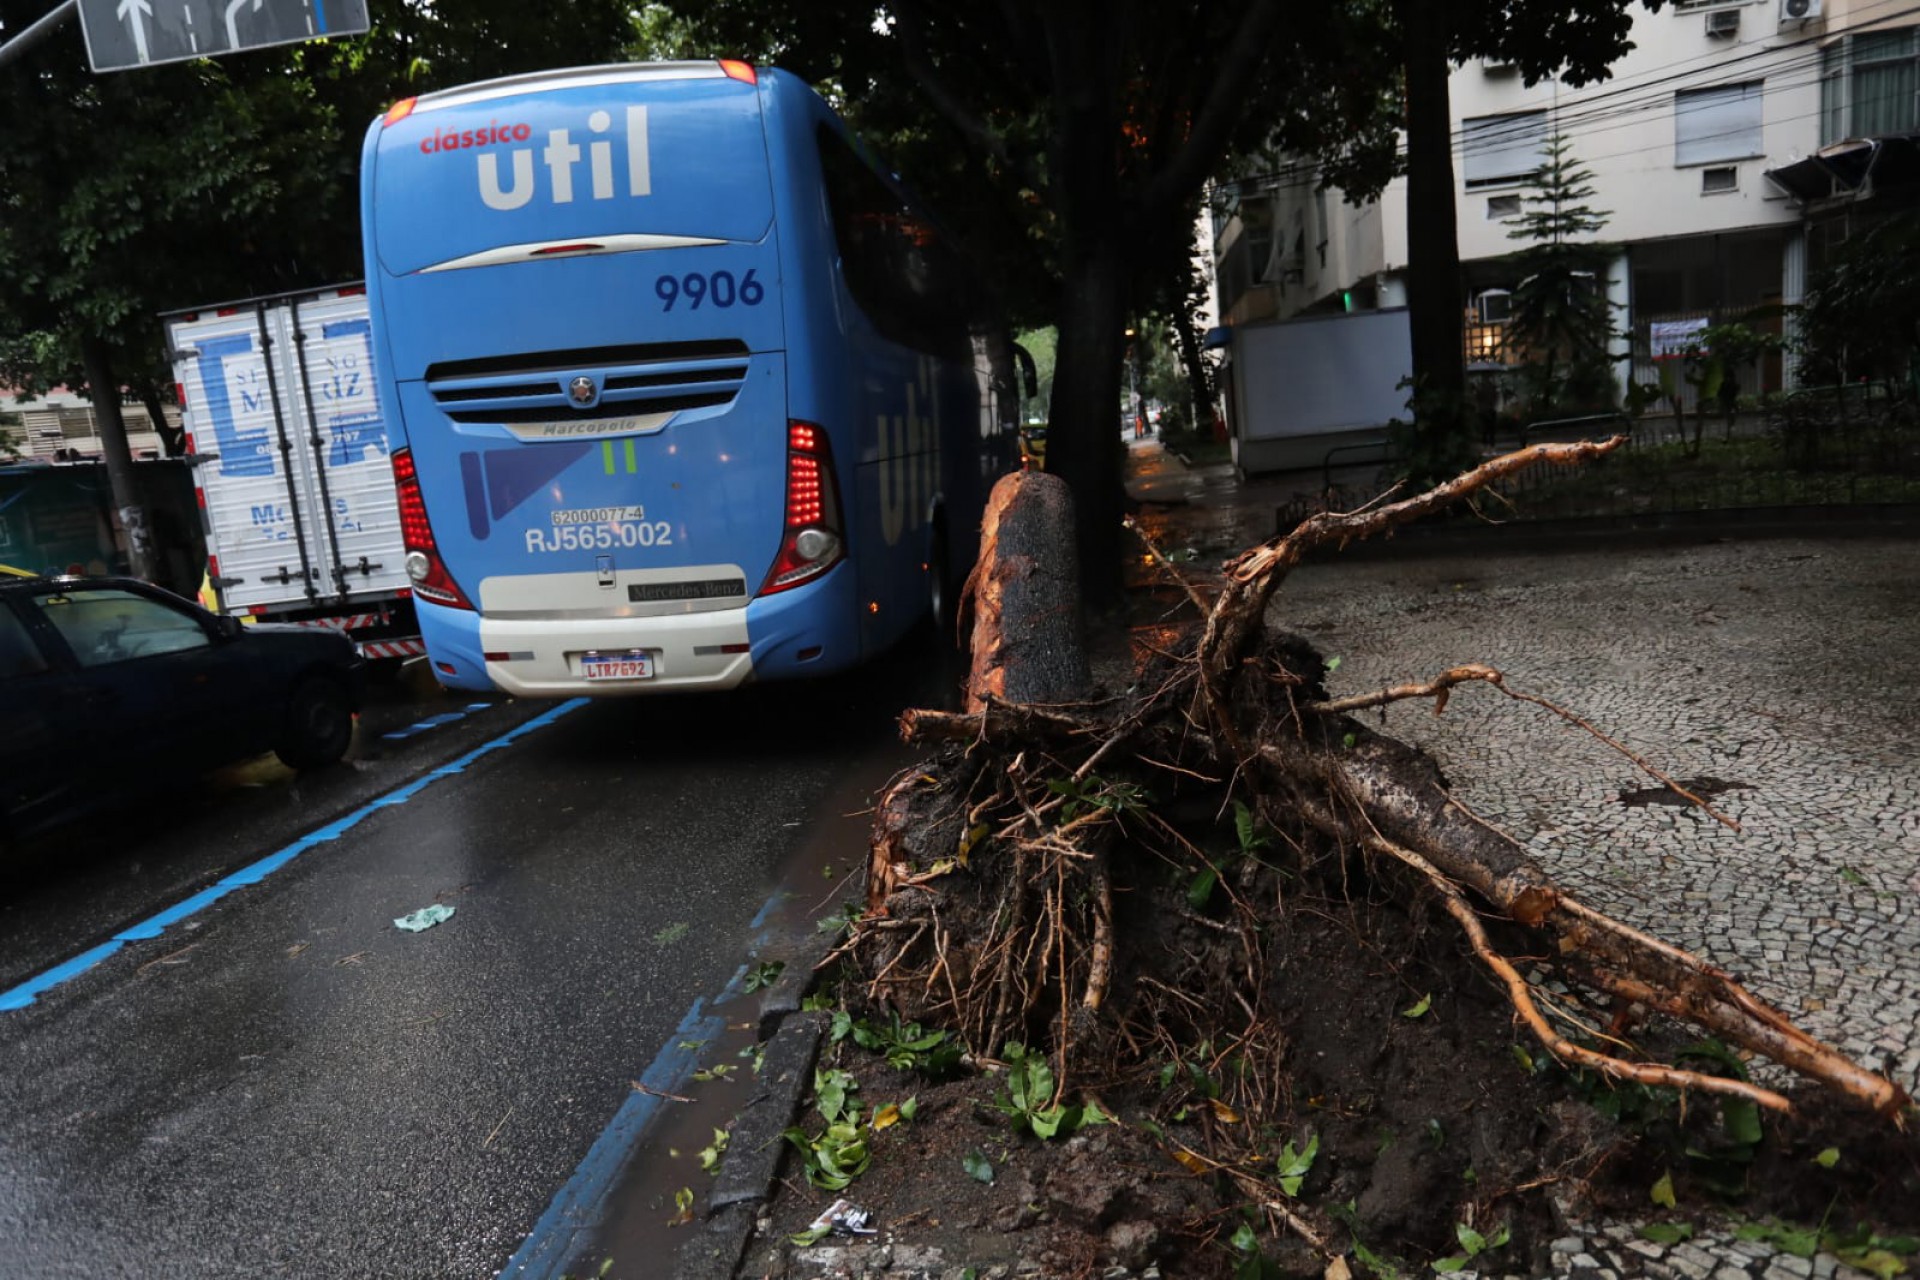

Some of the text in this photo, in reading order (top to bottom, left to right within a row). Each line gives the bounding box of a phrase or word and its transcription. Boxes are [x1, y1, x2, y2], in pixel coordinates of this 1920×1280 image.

[477, 105, 651, 210] util
[655, 269, 764, 312] 9906
[543, 419, 636, 435] Marcopolo
[553, 507, 643, 524] 62000077-4
[525, 522, 672, 553] RJ565.002
[587, 662, 646, 678] LTR7G92
